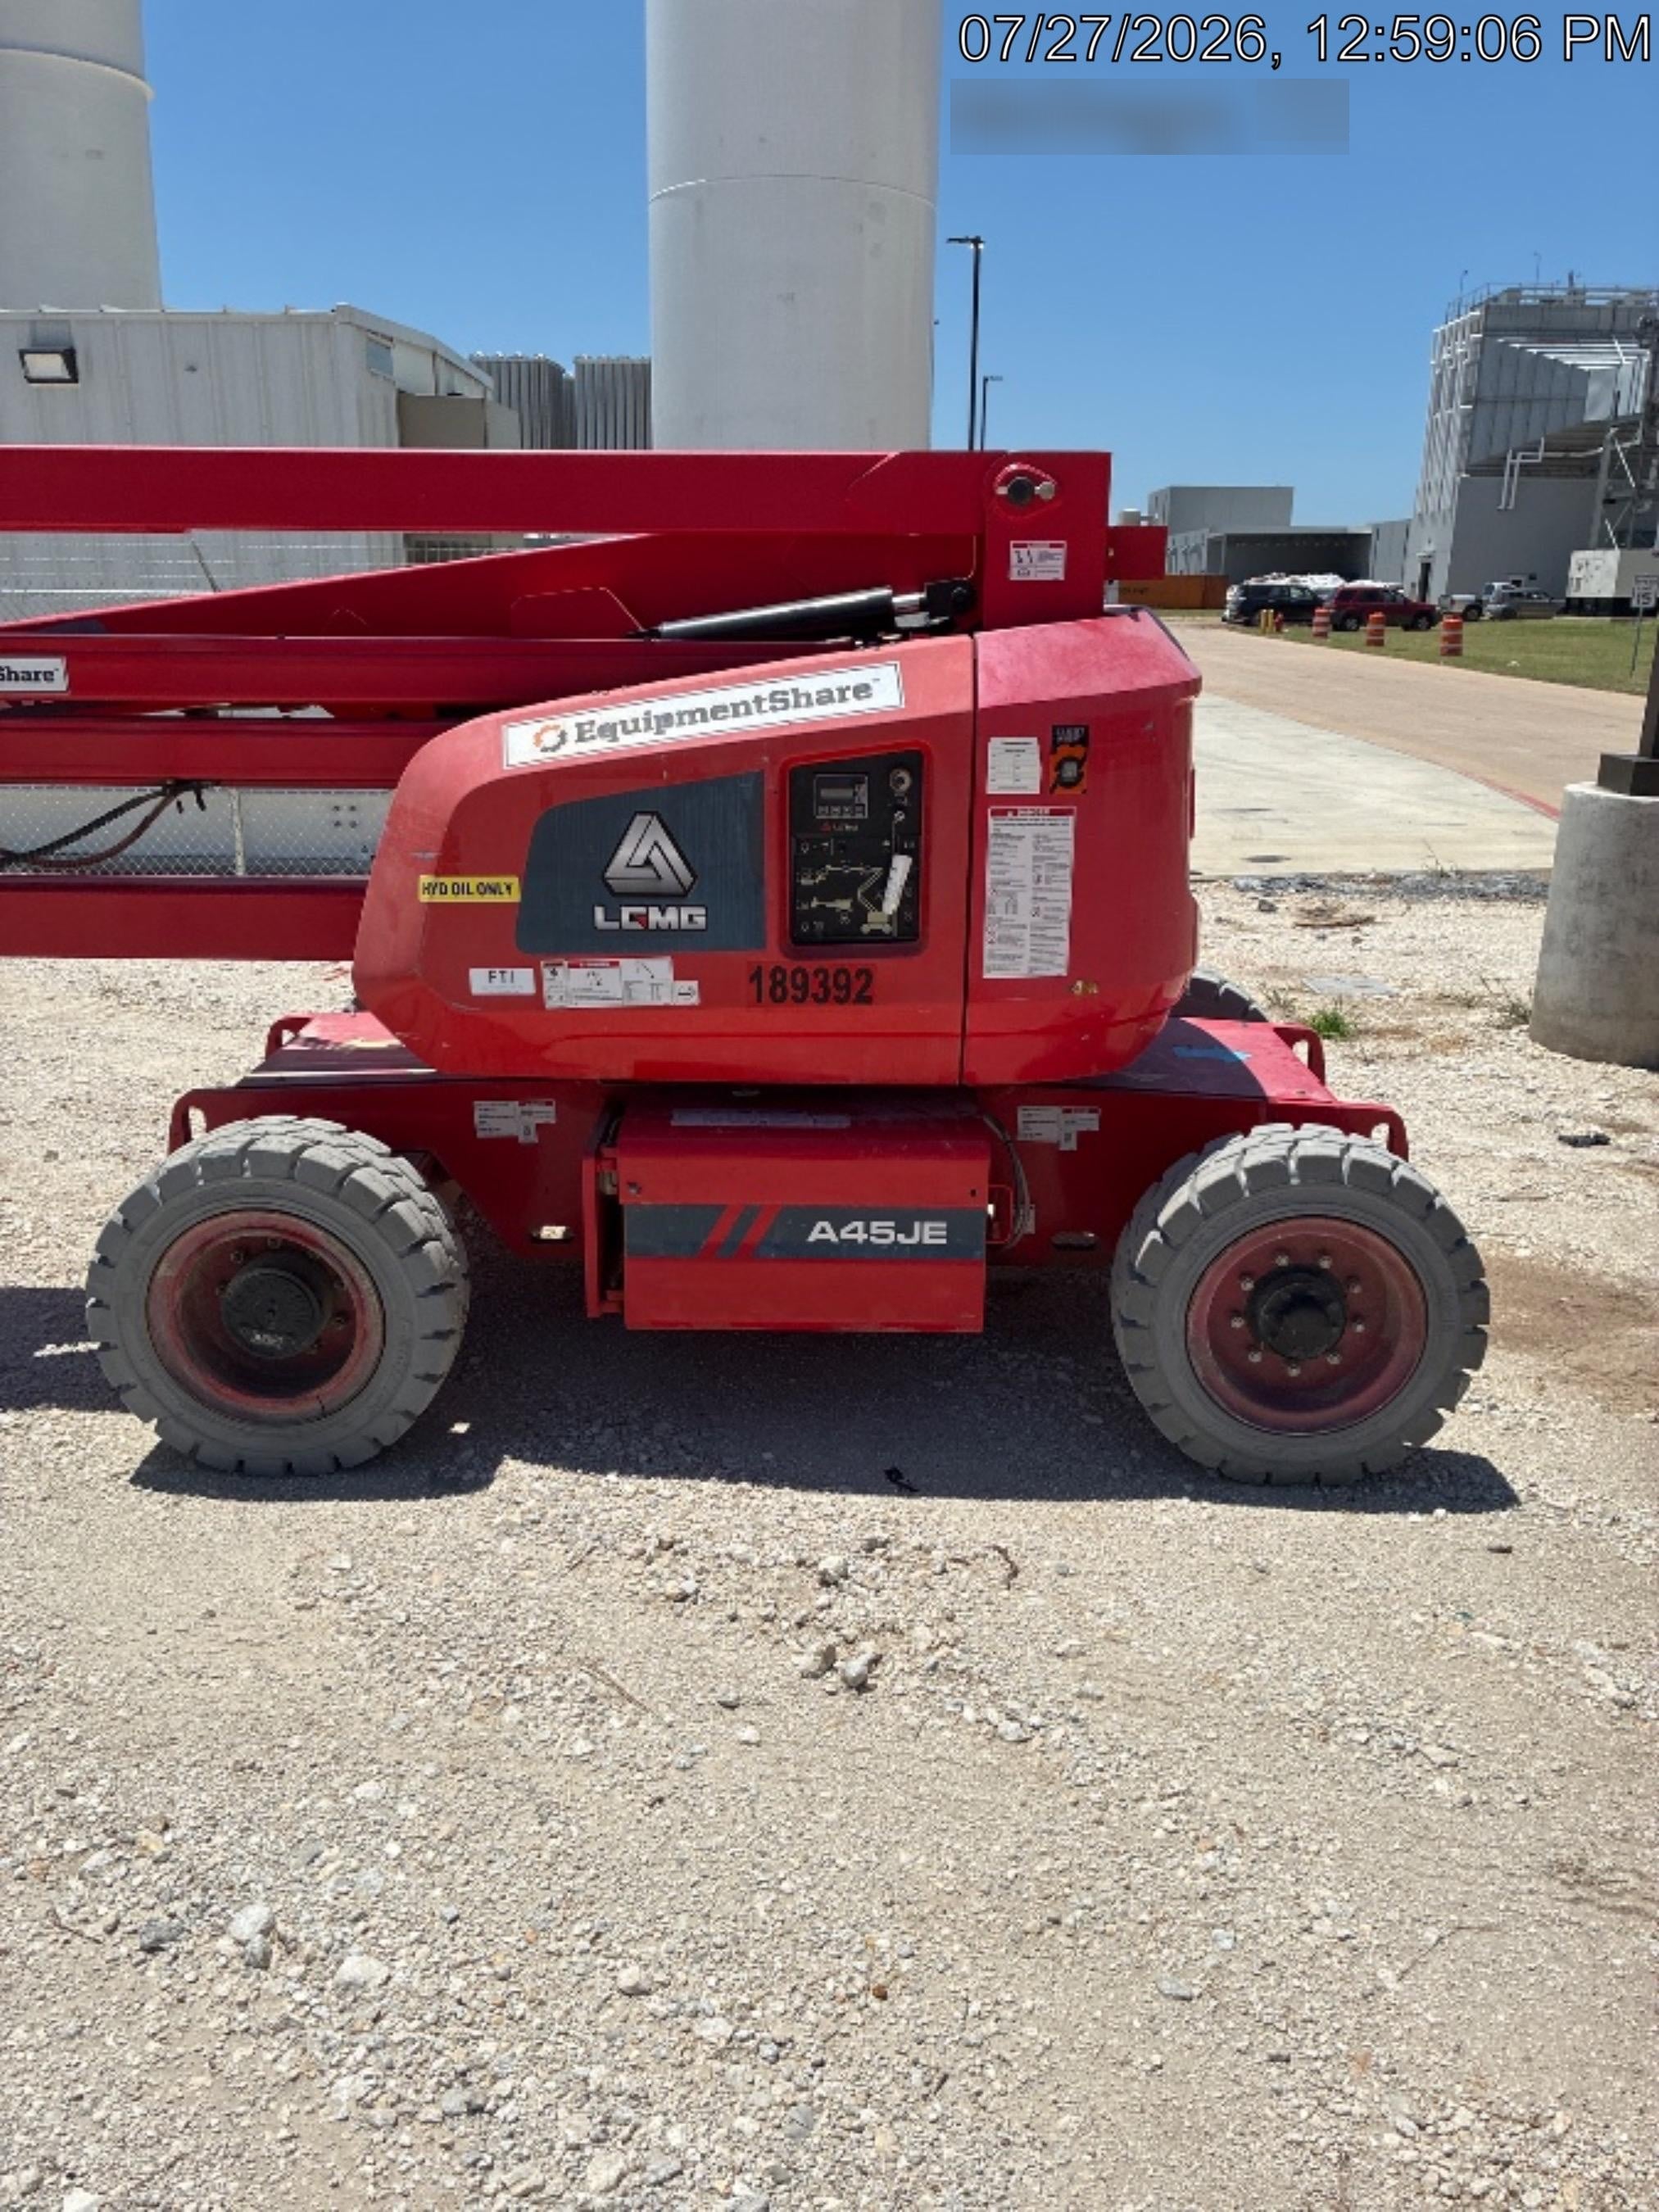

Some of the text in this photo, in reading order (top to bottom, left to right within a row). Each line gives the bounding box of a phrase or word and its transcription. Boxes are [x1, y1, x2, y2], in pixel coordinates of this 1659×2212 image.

[573, 682, 873, 744] EquipmentShare
[422, 882, 514, 895] HYD OIL ONLY
[749, 965, 874, 1005] 189392
[806, 1220, 948, 1245] A45JE
